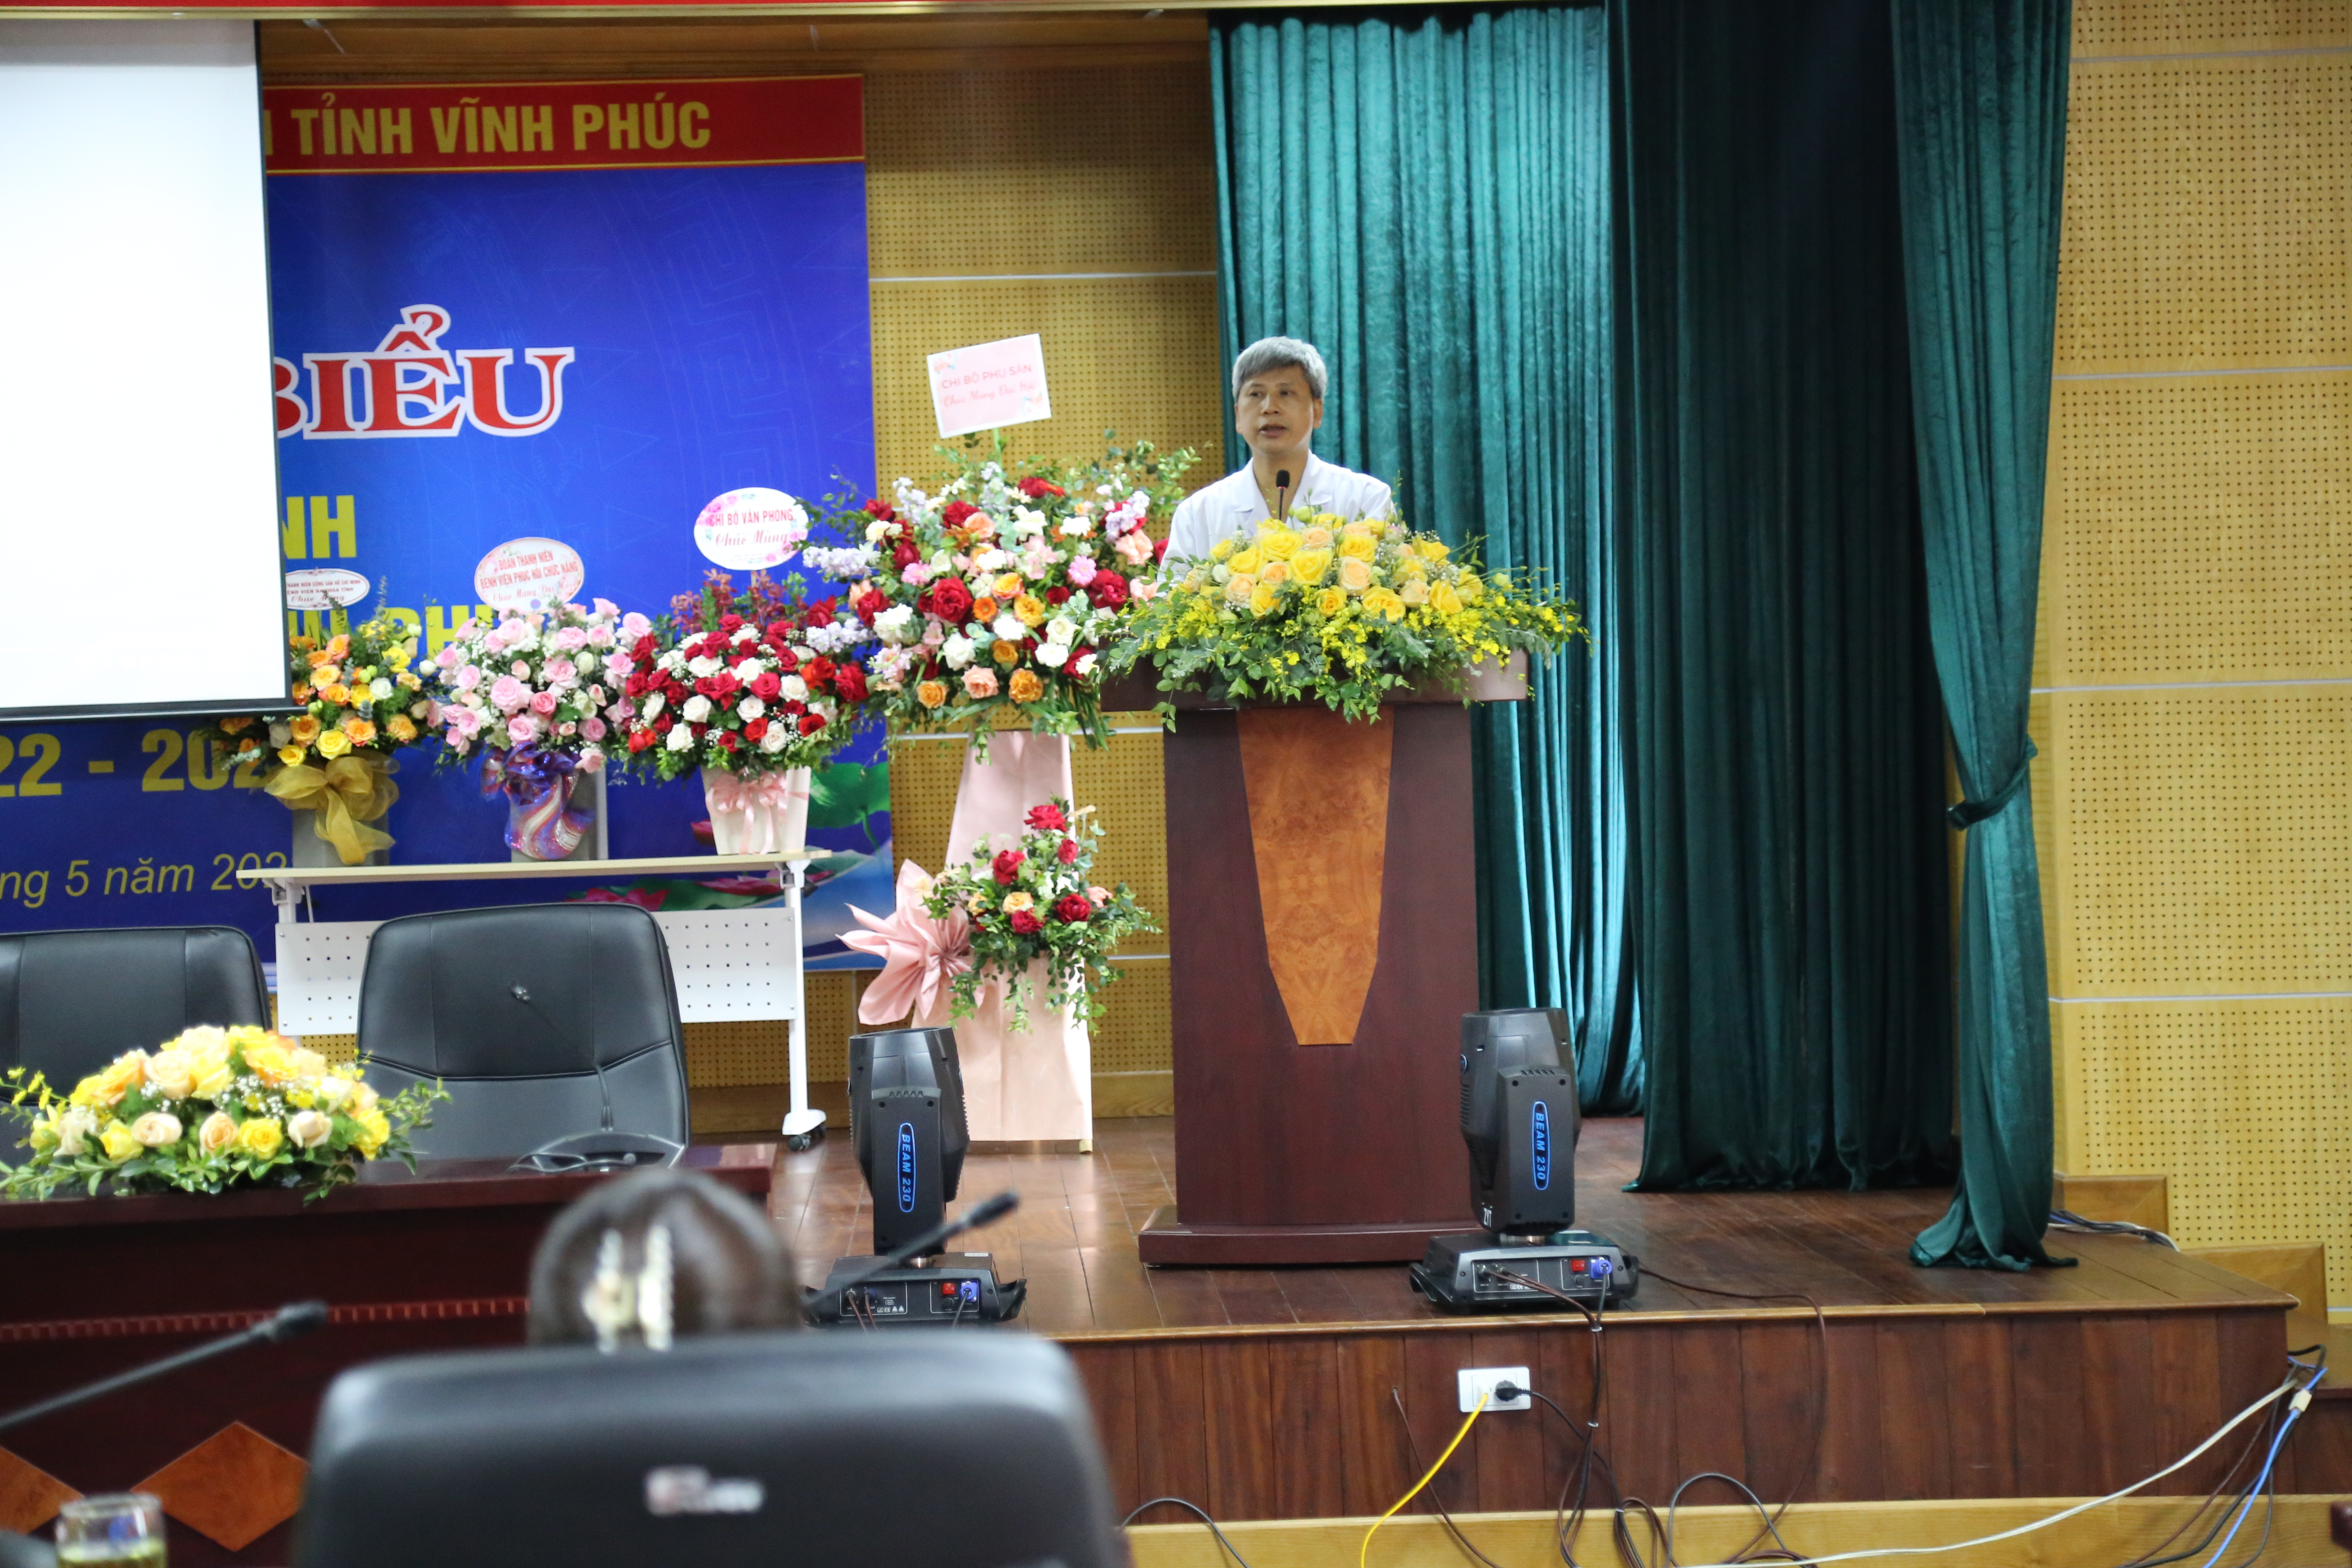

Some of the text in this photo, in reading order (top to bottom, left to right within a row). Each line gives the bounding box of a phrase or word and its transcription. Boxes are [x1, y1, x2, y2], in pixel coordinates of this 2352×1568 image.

[291, 92, 413, 155] TỈNH
[430, 96, 554, 153] VĨNH
[572, 92, 710, 150] PHÚC
[942, 378, 960, 389] CHI
[709, 506, 793, 528] CHI BỘ VĂN PHÒNG
[65, 860, 89, 897] 5
[104, 857, 195, 896] năm
[902, 1134, 911, 1202] BEAM 230
[1536, 1112, 1546, 1180] BEAM 230
